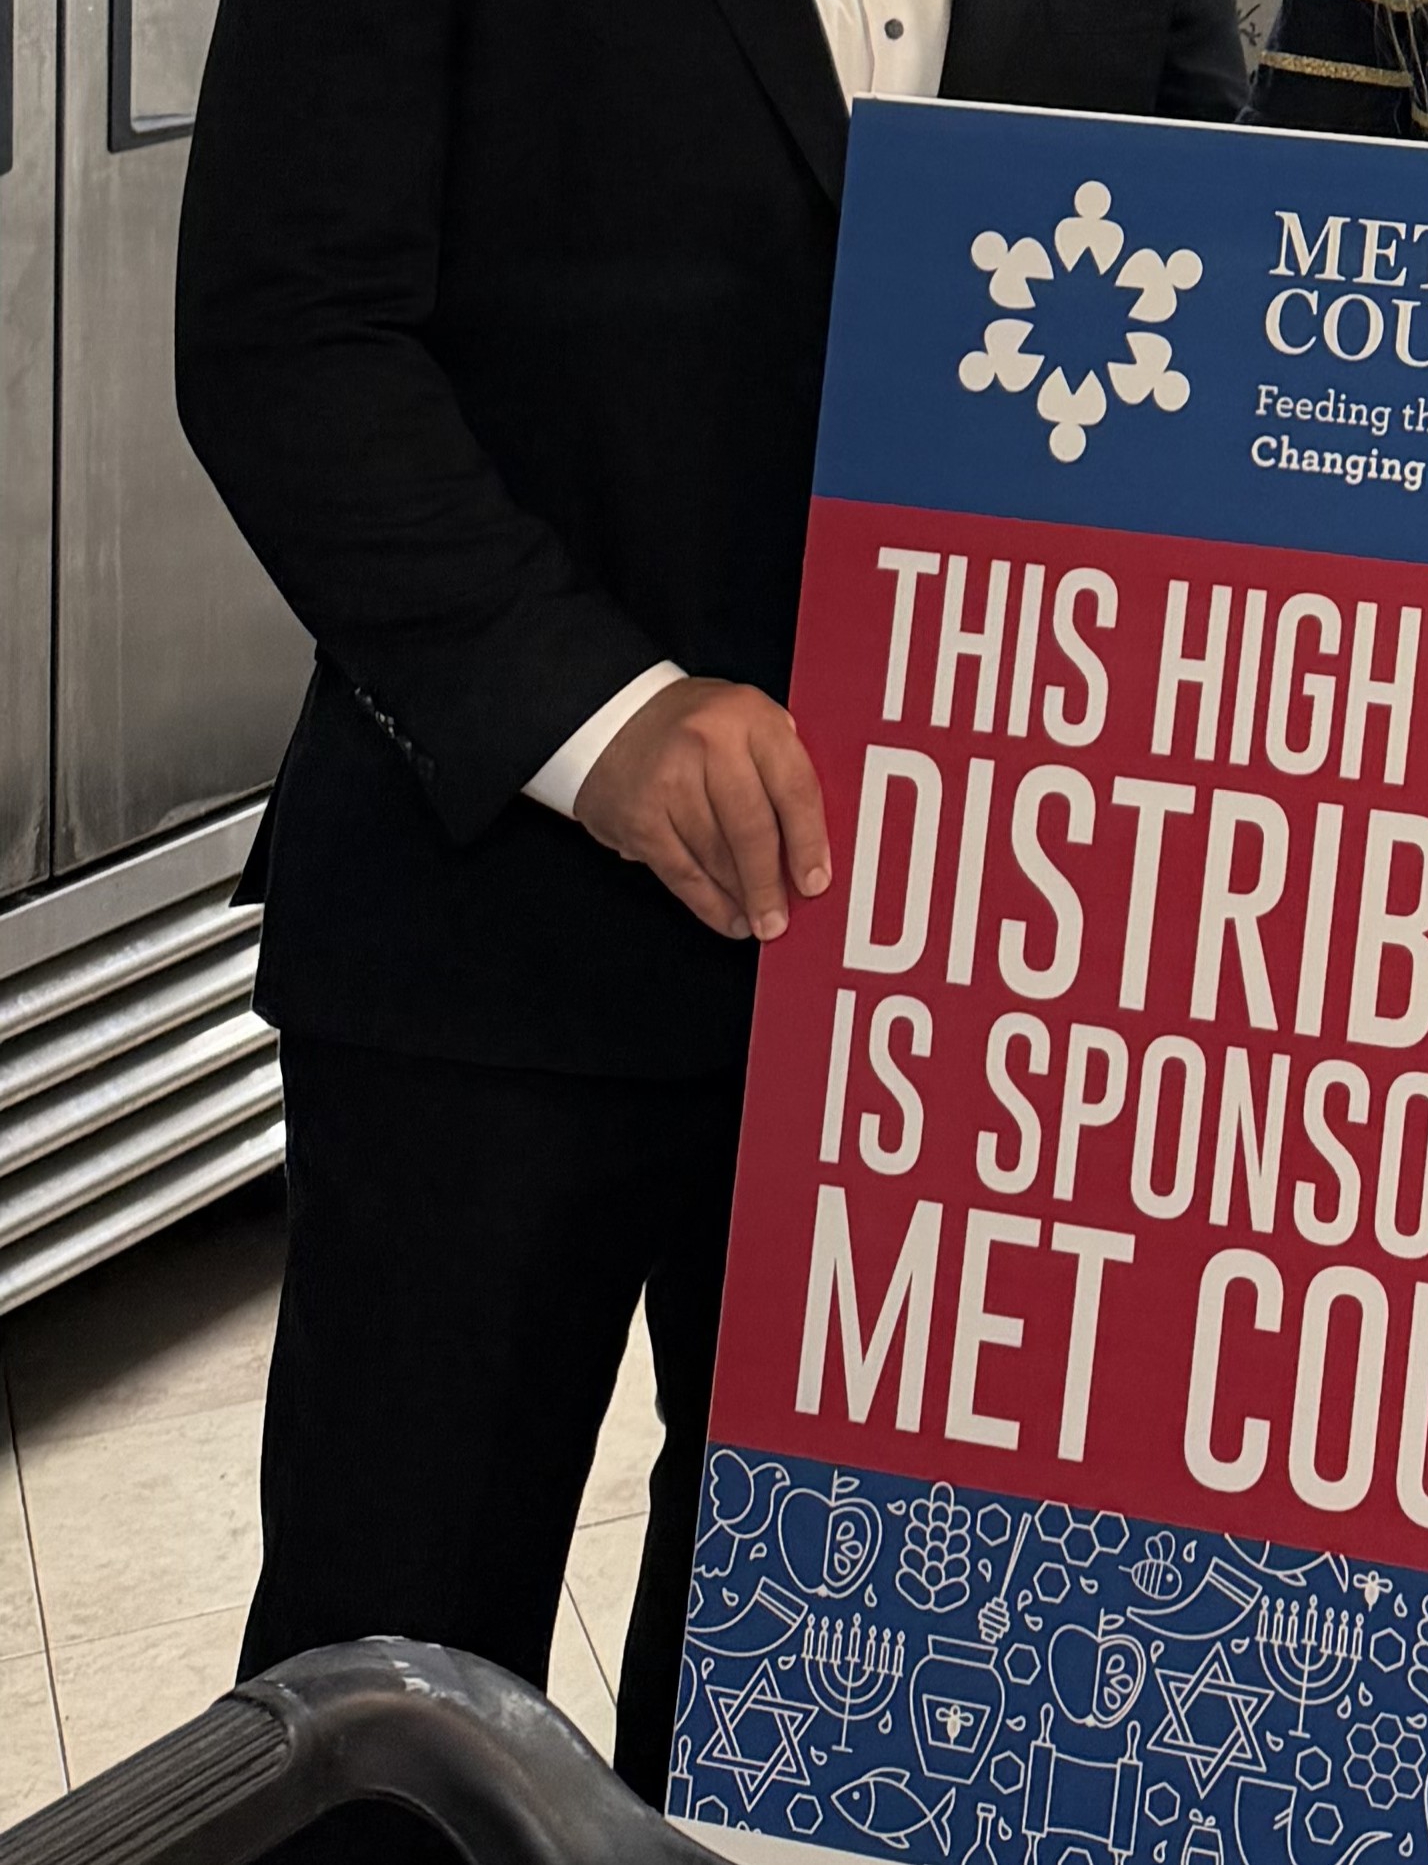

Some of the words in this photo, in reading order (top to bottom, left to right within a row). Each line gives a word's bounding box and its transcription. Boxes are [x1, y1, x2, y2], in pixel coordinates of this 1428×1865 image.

[1252, 435, 1425, 490] Changing
[1256, 385, 1391, 435] Feeding
[878, 548, 1118, 746] THIS
[1152, 580, 1421, 785] HIGH
[820, 989, 932, 1174] IS
[796, 1185, 1135, 1461] MET
